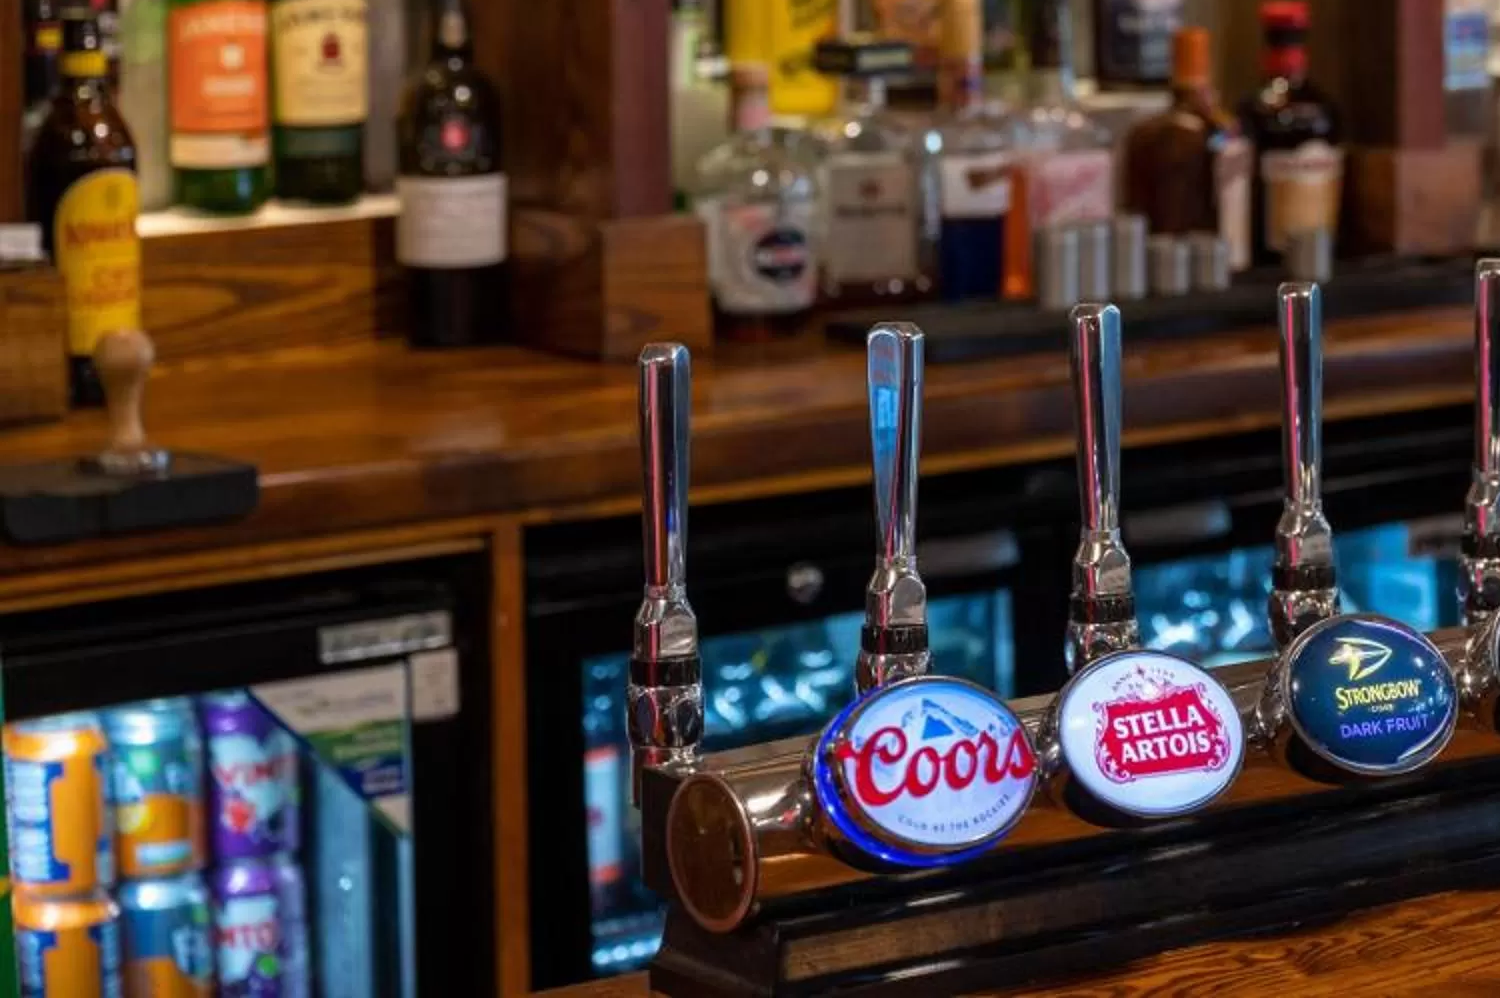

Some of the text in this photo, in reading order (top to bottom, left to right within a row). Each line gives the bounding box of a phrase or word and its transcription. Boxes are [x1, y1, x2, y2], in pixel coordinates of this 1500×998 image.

[1336, 679, 1422, 711] STRONGBOW
[1113, 705, 1206, 740] STELLA
[1341, 714, 1429, 740] DARK FRUIT
[1122, 731, 1212, 765] ARTOIS
[834, 726, 1038, 808] Coors
